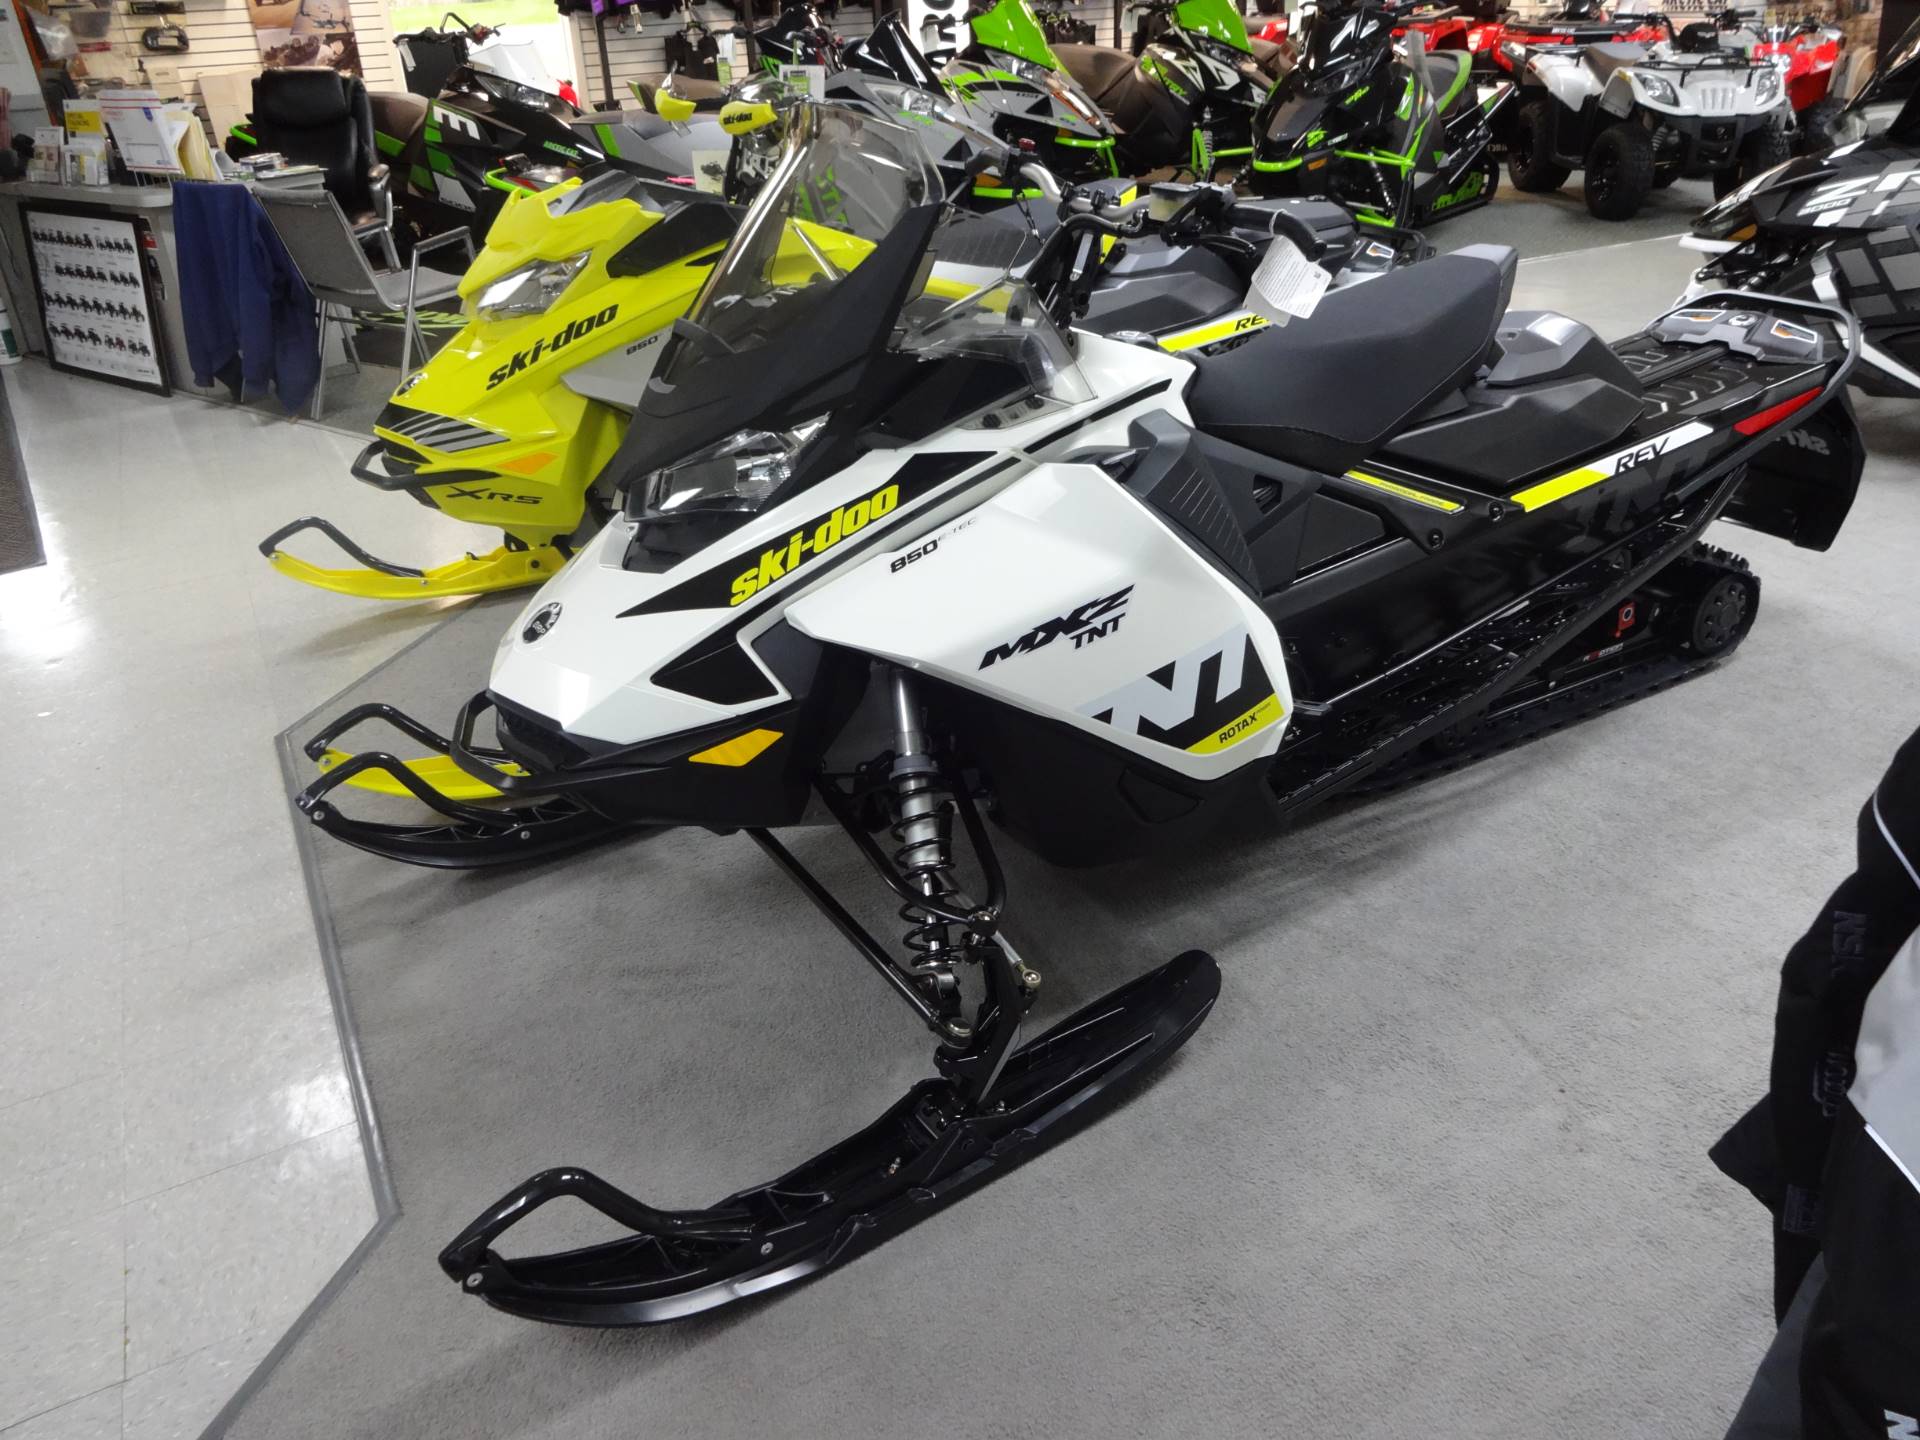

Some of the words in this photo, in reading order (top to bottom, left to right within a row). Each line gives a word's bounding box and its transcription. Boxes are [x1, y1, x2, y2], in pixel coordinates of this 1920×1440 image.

[1235, 314, 1270, 332] RE
[486, 303, 619, 392] ski-doo
[625, 336, 659, 356] 850
[1613, 435, 1671, 476] REV
[445, 486, 543, 506] XRS
[729, 483, 899, 607] ski-doo
[890, 537, 938, 574] 850
[1069, 611, 1127, 650] TNT
[1218, 711, 1259, 744] ROTAX
